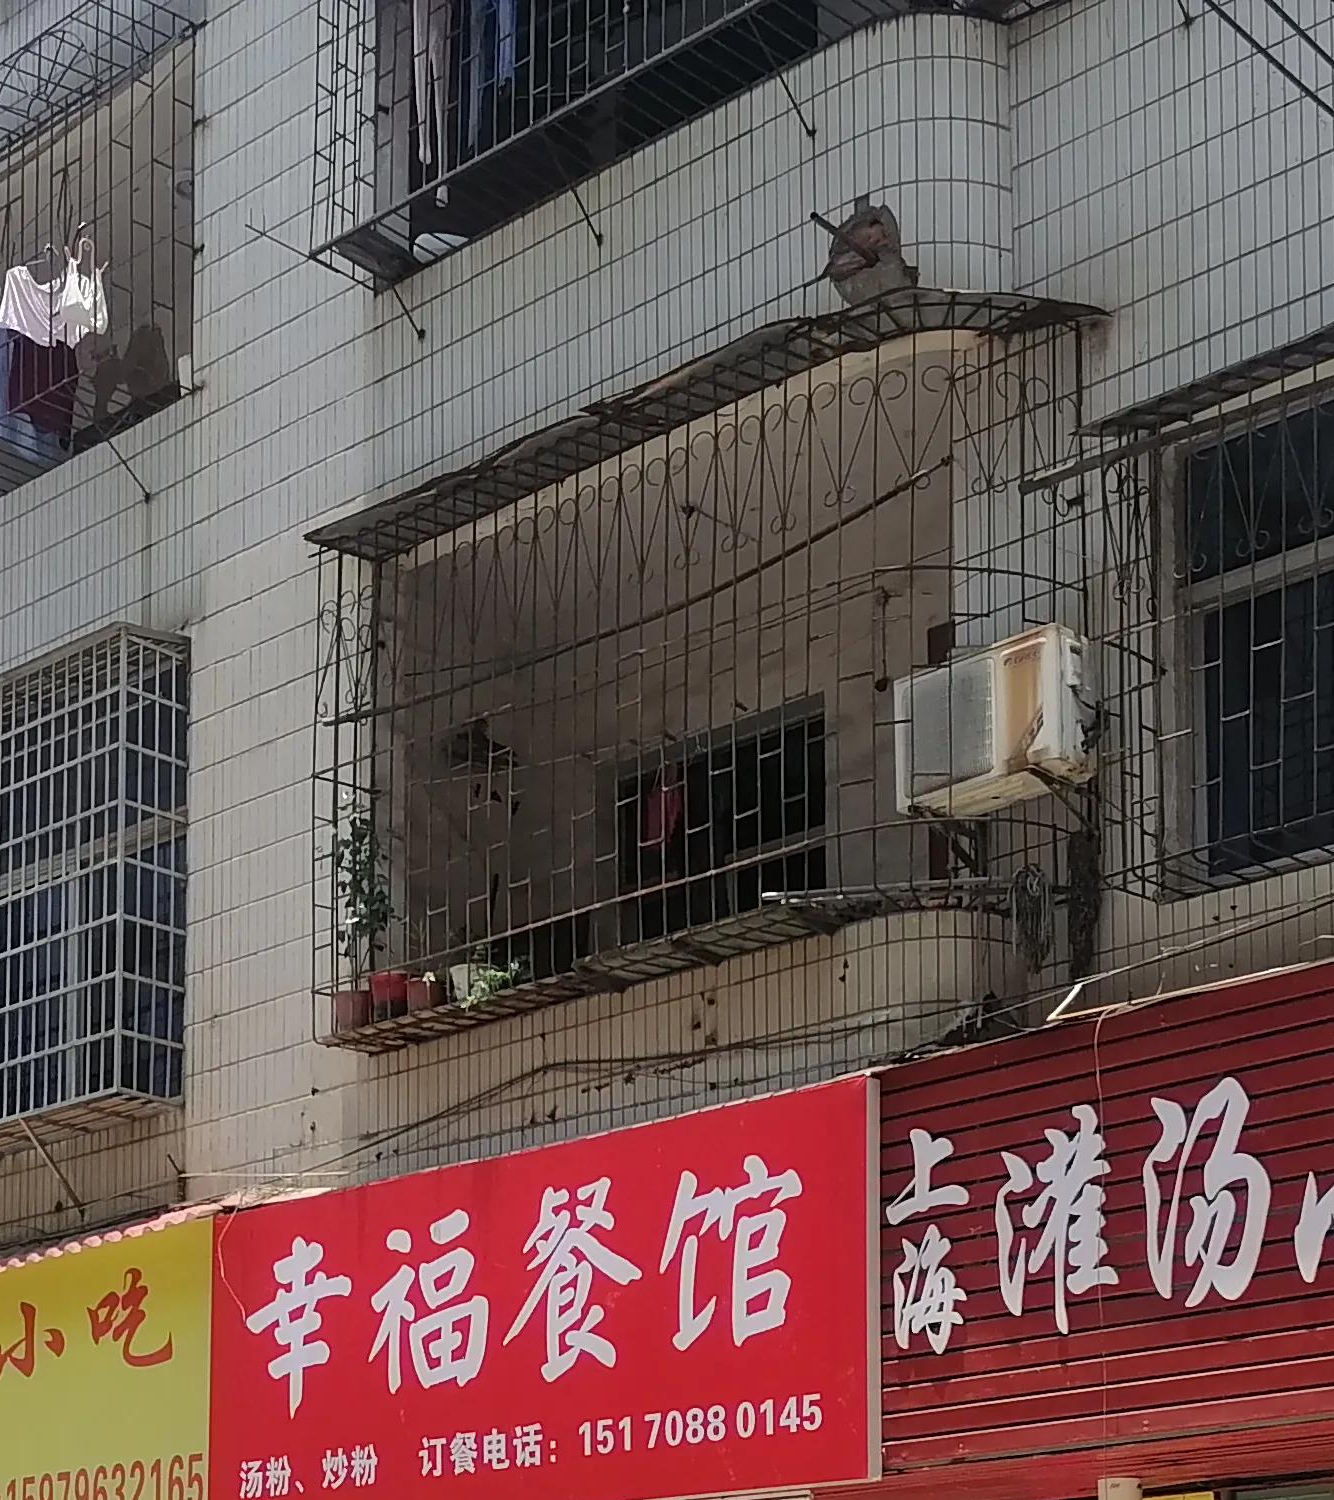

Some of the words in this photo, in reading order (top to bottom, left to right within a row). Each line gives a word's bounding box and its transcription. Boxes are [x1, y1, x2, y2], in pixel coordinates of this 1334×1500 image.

[246, 1154, 803, 1419] 幸福餐馆
[886, 1128, 968, 1355] 上海
[238, 1444, 378, 1500] 汤粉、炒粉
[579, 1414, 634, 1457] 151
[643, 1404, 725, 1451] 7088
[736, 1393, 823, 1441] 0145
